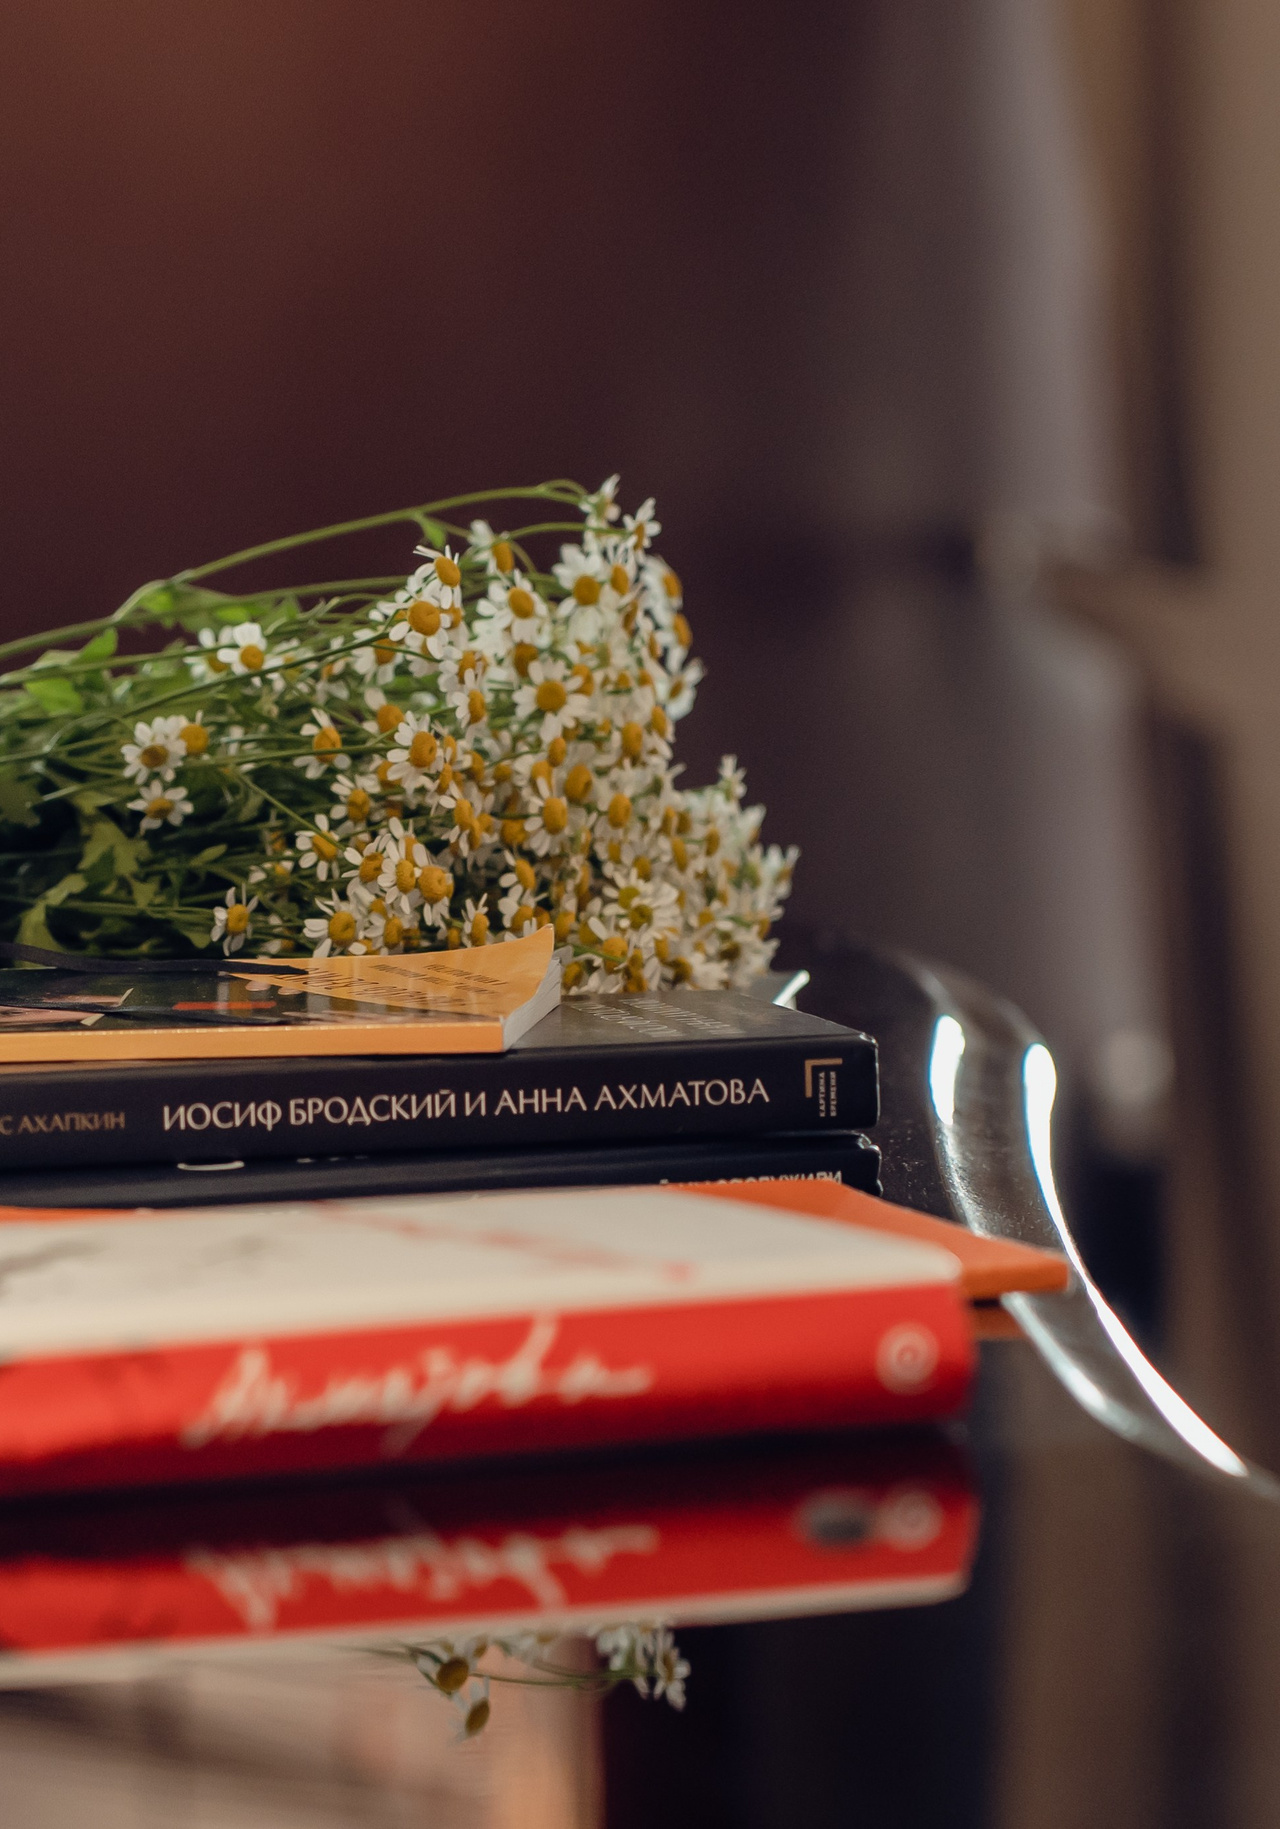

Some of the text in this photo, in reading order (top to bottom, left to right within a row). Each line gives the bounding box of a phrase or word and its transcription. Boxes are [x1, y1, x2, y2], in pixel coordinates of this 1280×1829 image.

[17, 1112, 126, 1135] АХАПКИН
[163, 1078, 771, 1132] ИОСИФ БРОДСКИЙ И АННА АХМАТОВА
